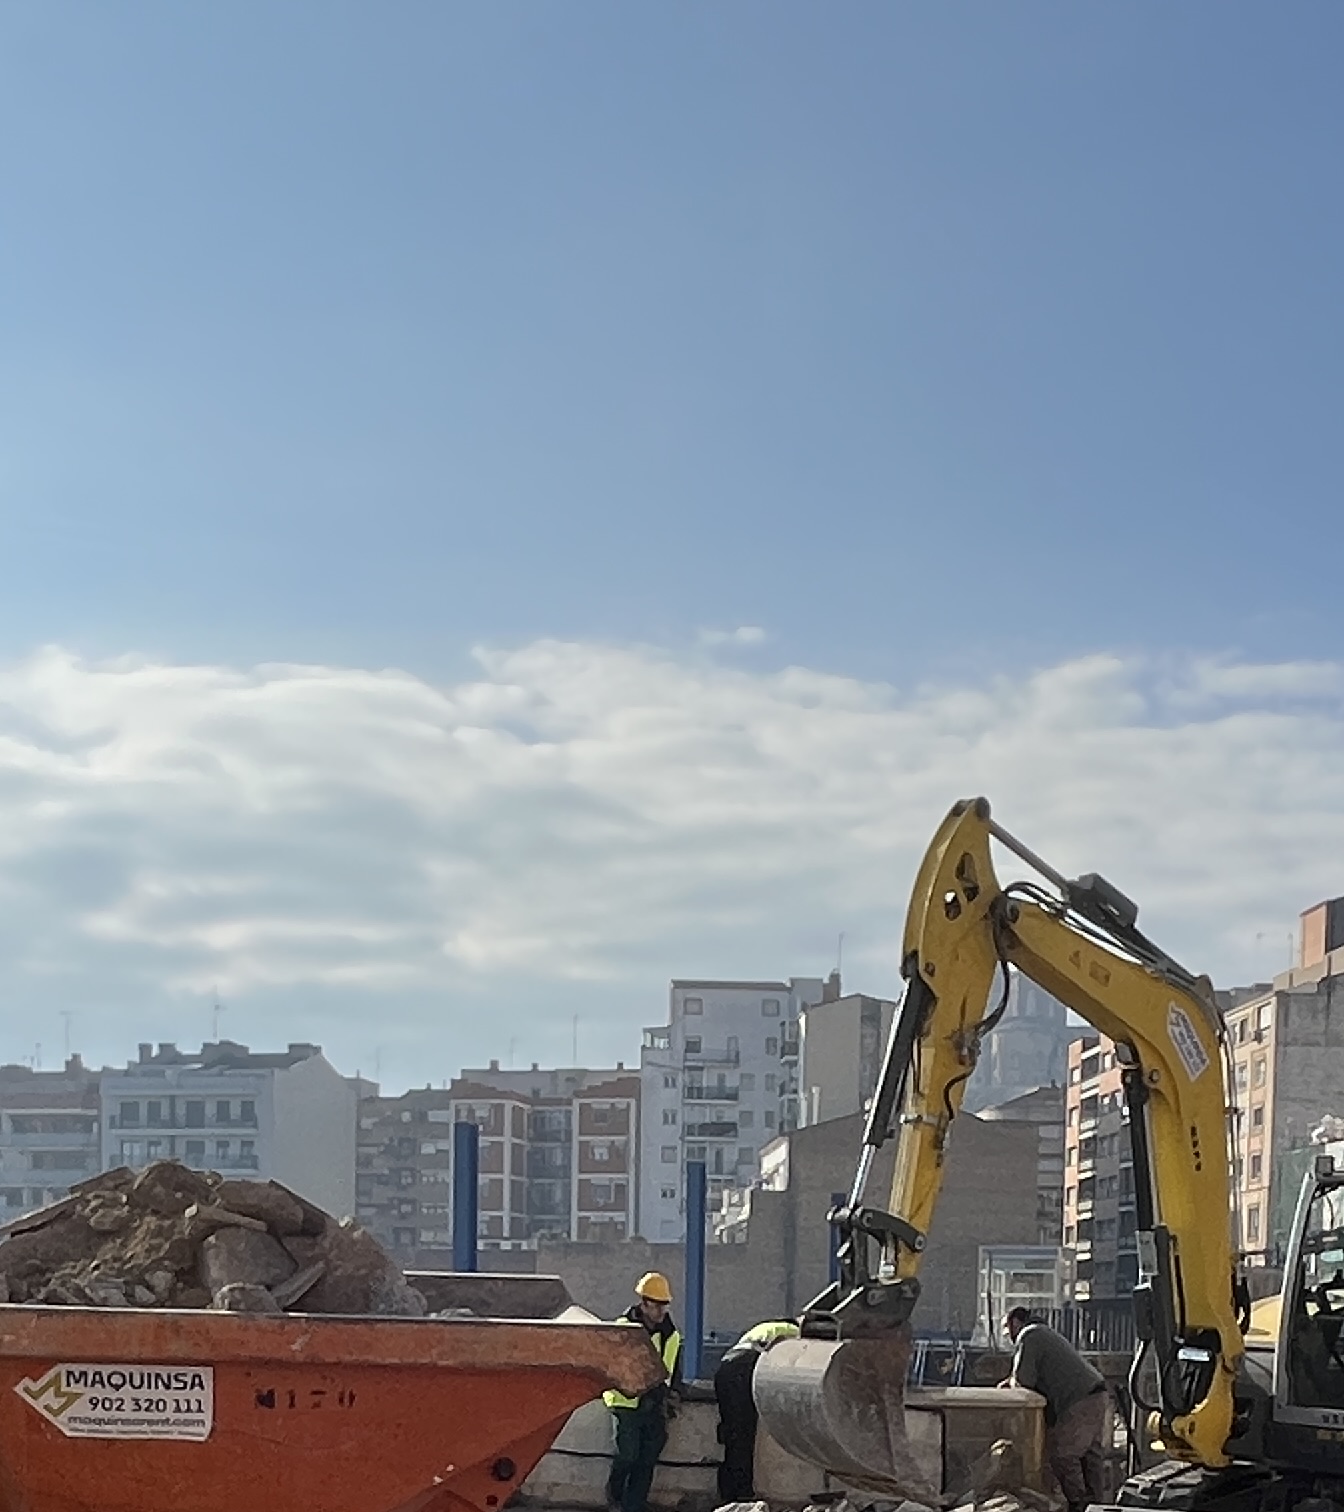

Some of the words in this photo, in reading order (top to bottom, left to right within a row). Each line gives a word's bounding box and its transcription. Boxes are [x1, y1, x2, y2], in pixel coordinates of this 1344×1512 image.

[65, 1369, 205, 1391] MAQUINSA
[88, 1396, 126, 1412] 902
[130, 1398, 167, 1414] 320
[172, 1398, 205, 1414] 111
